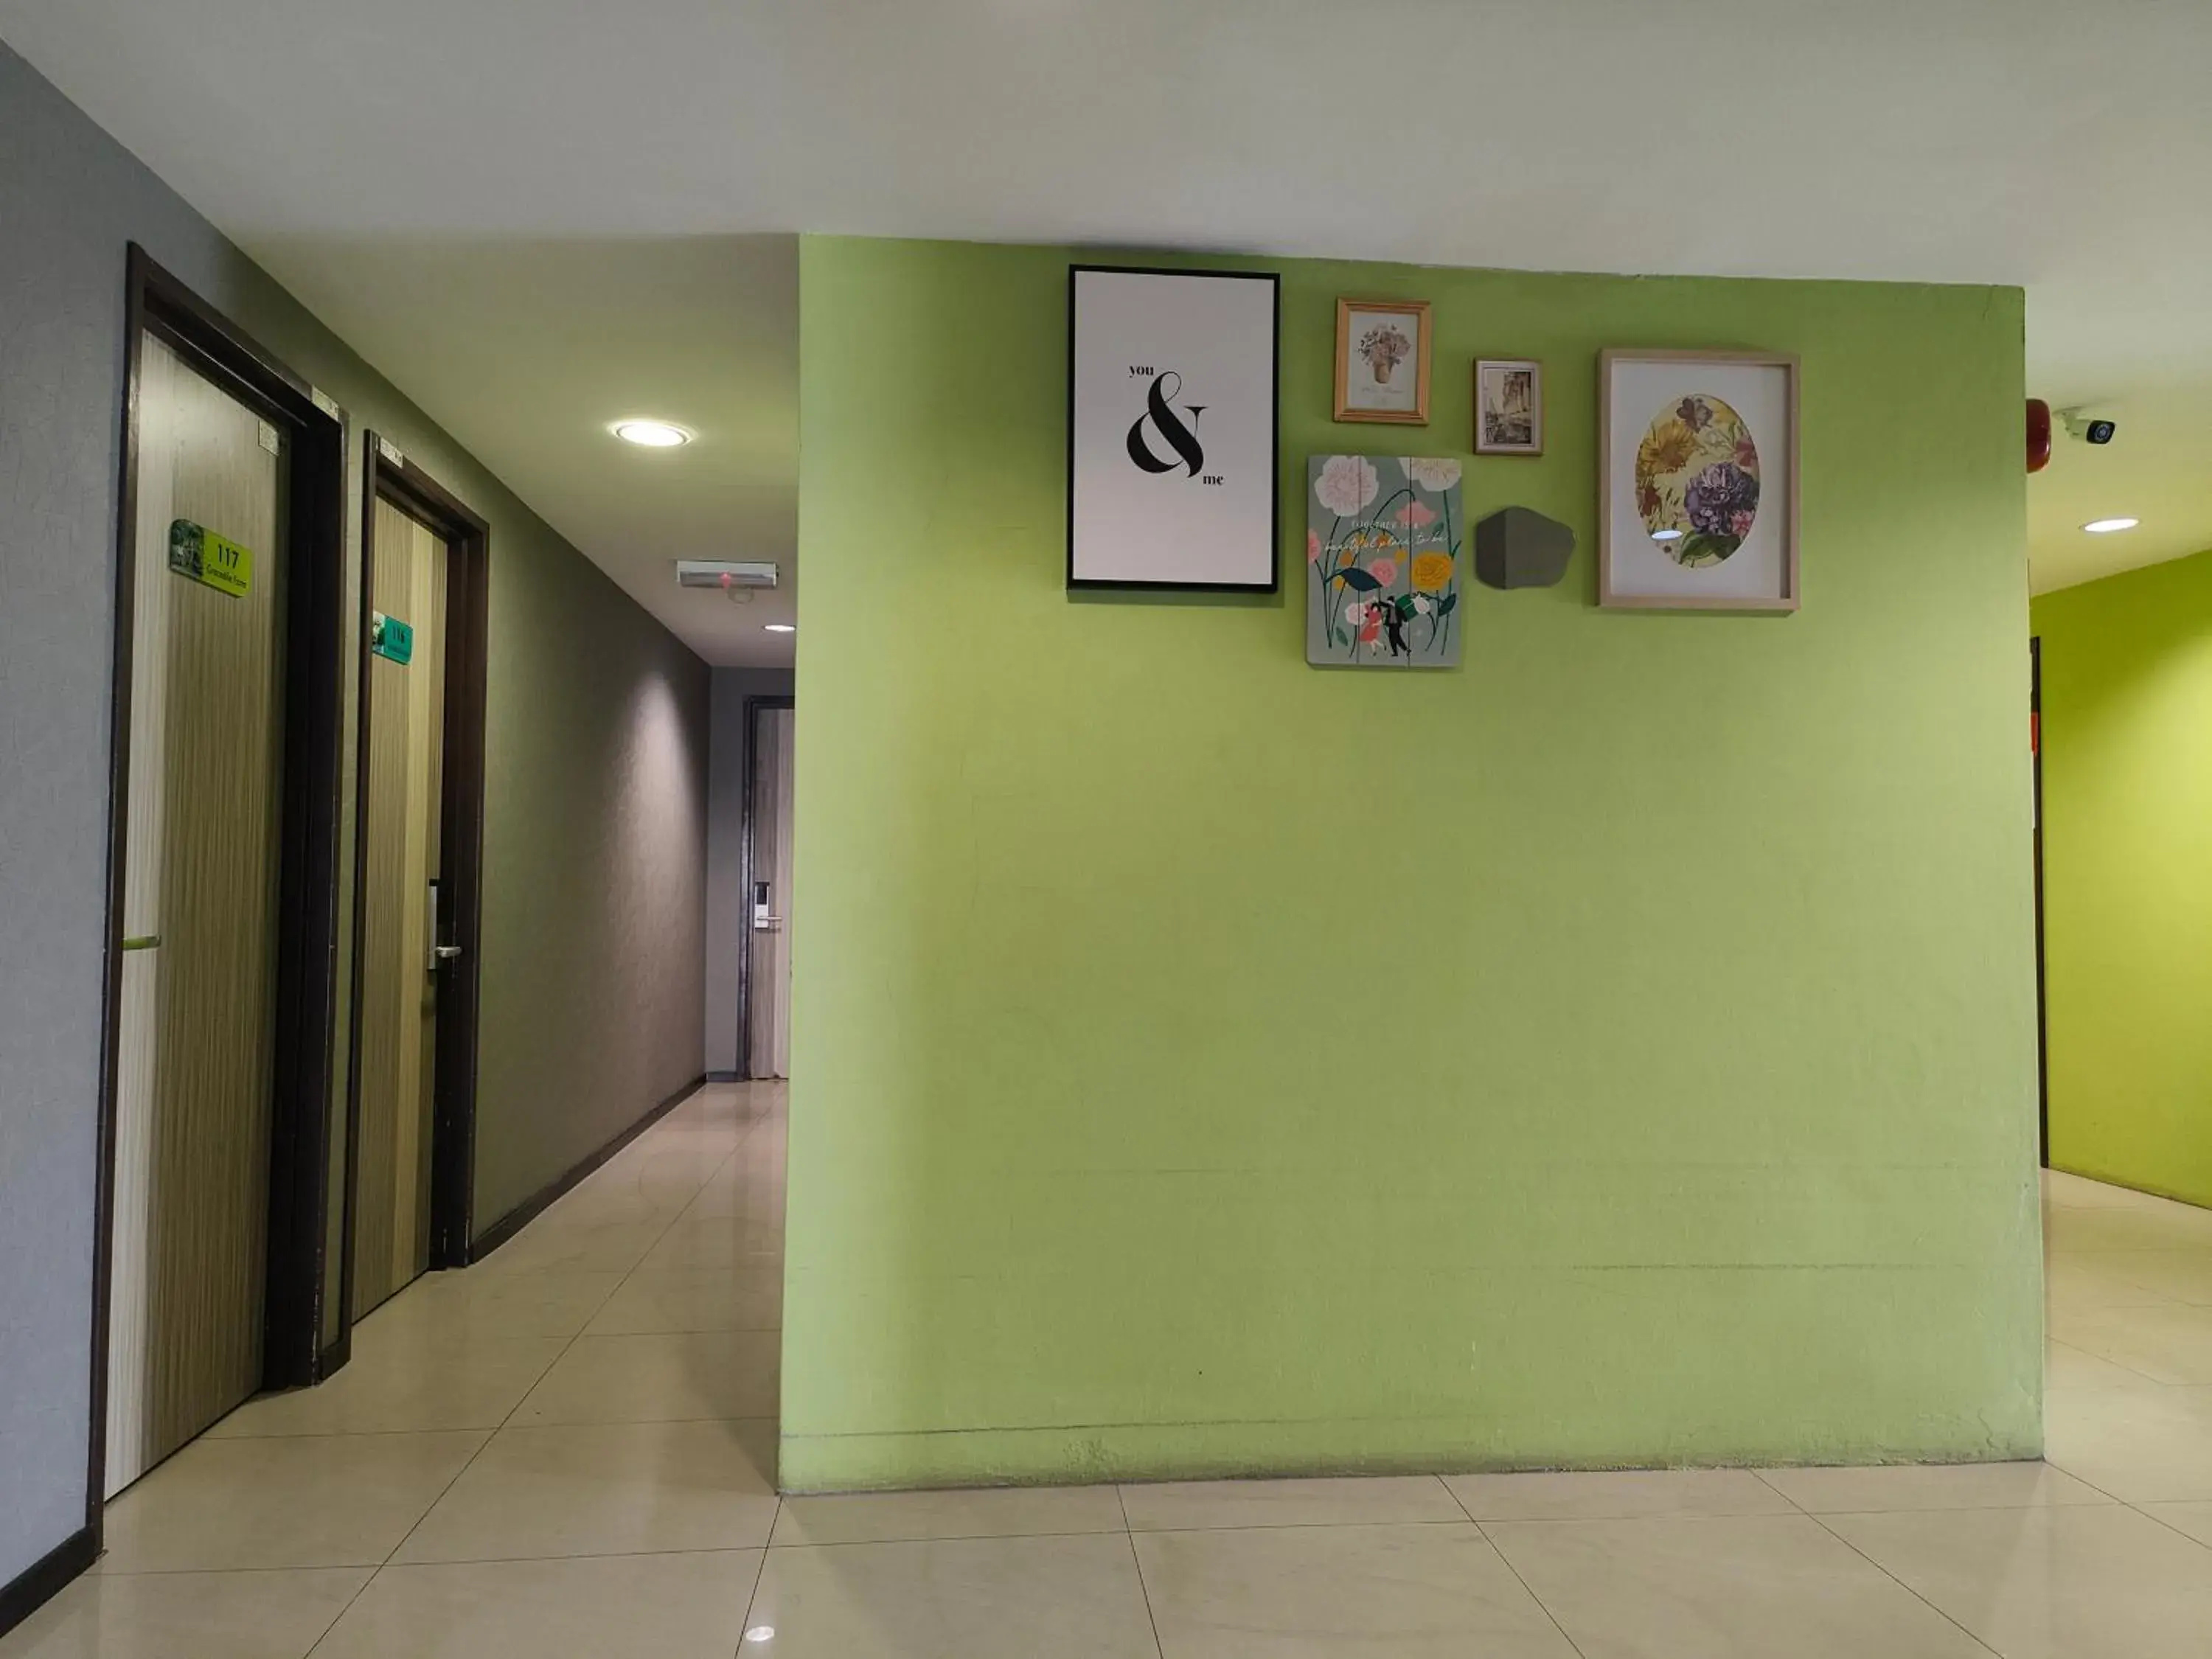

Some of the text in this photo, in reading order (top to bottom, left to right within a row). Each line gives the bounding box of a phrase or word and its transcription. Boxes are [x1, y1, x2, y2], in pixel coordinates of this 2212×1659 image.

[1129, 365, 1154, 378] you
[1127, 371, 1208, 478] &
[1203, 475, 1224, 486] me
[218, 543, 239, 569] 117
